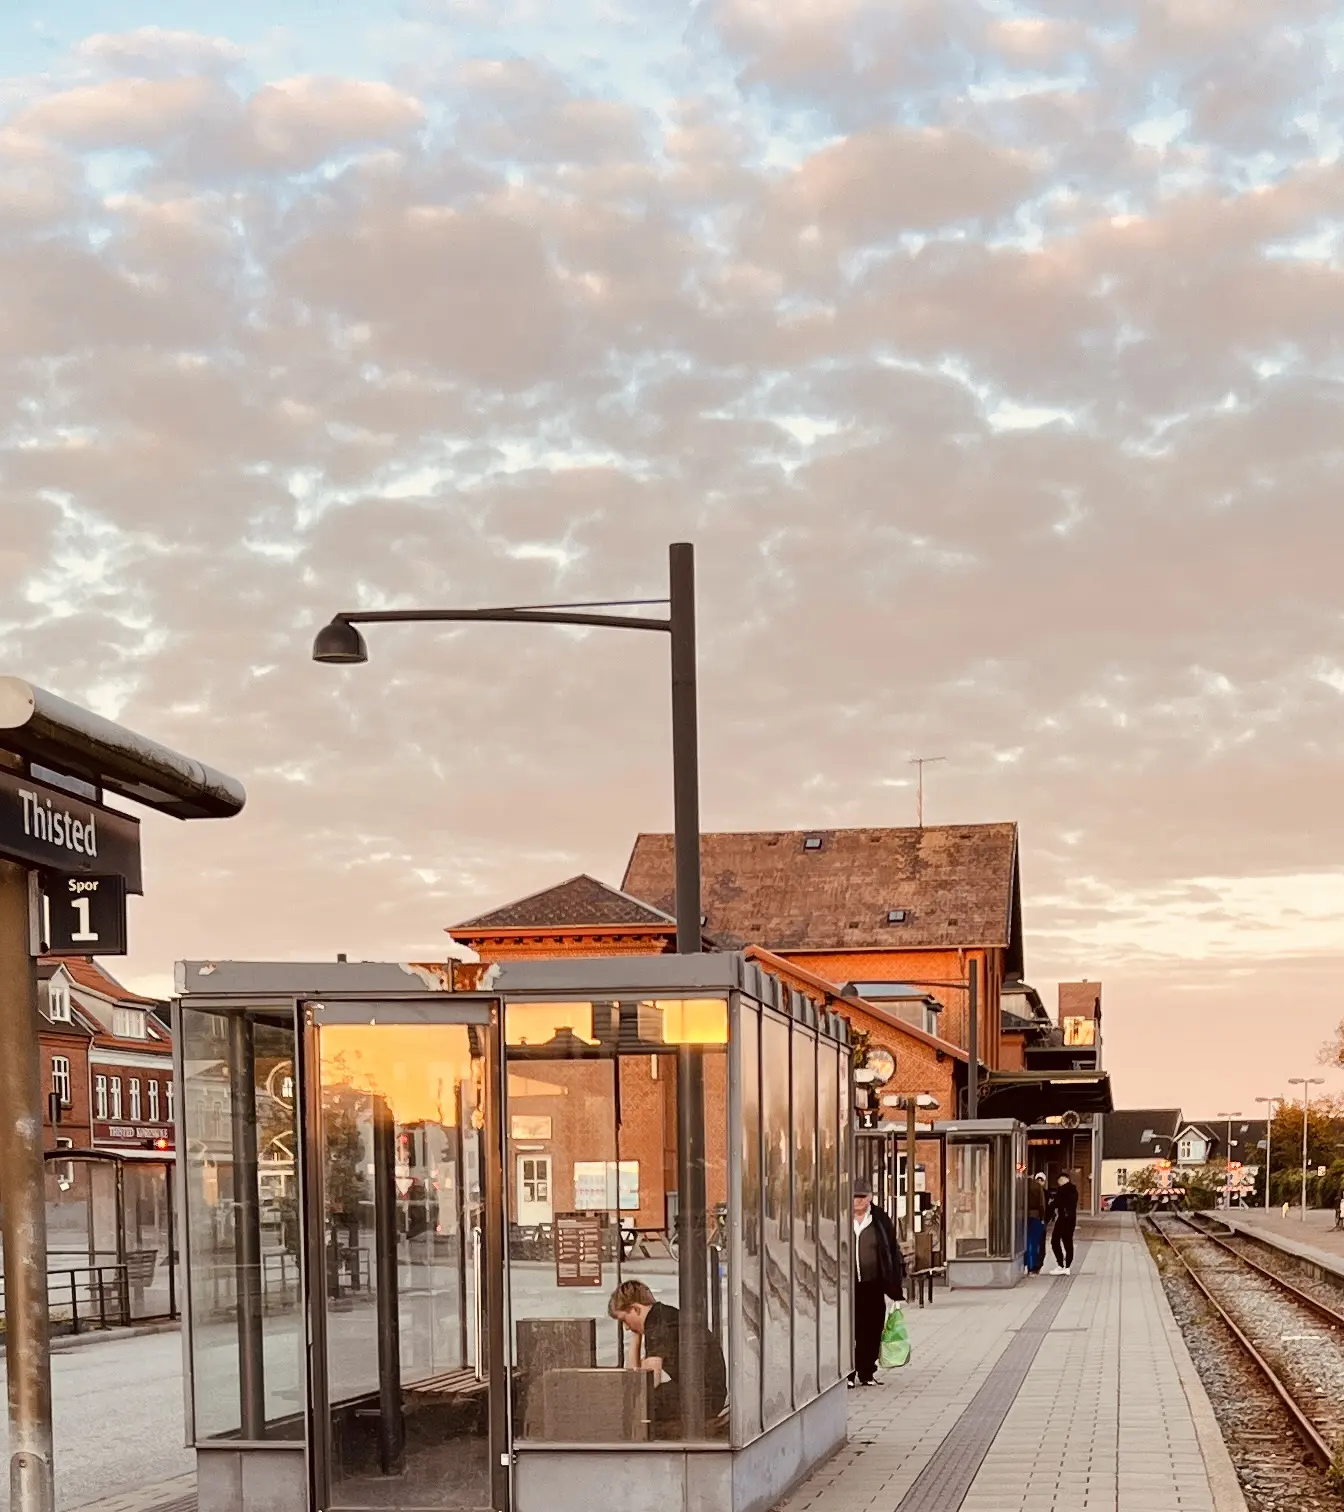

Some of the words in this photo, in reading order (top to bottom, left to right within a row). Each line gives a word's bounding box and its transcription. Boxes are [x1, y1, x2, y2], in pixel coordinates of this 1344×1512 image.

[18, 788, 98, 858] Thisted
[68, 878, 99, 894] Spor
[71, 897, 99, 942] 1
